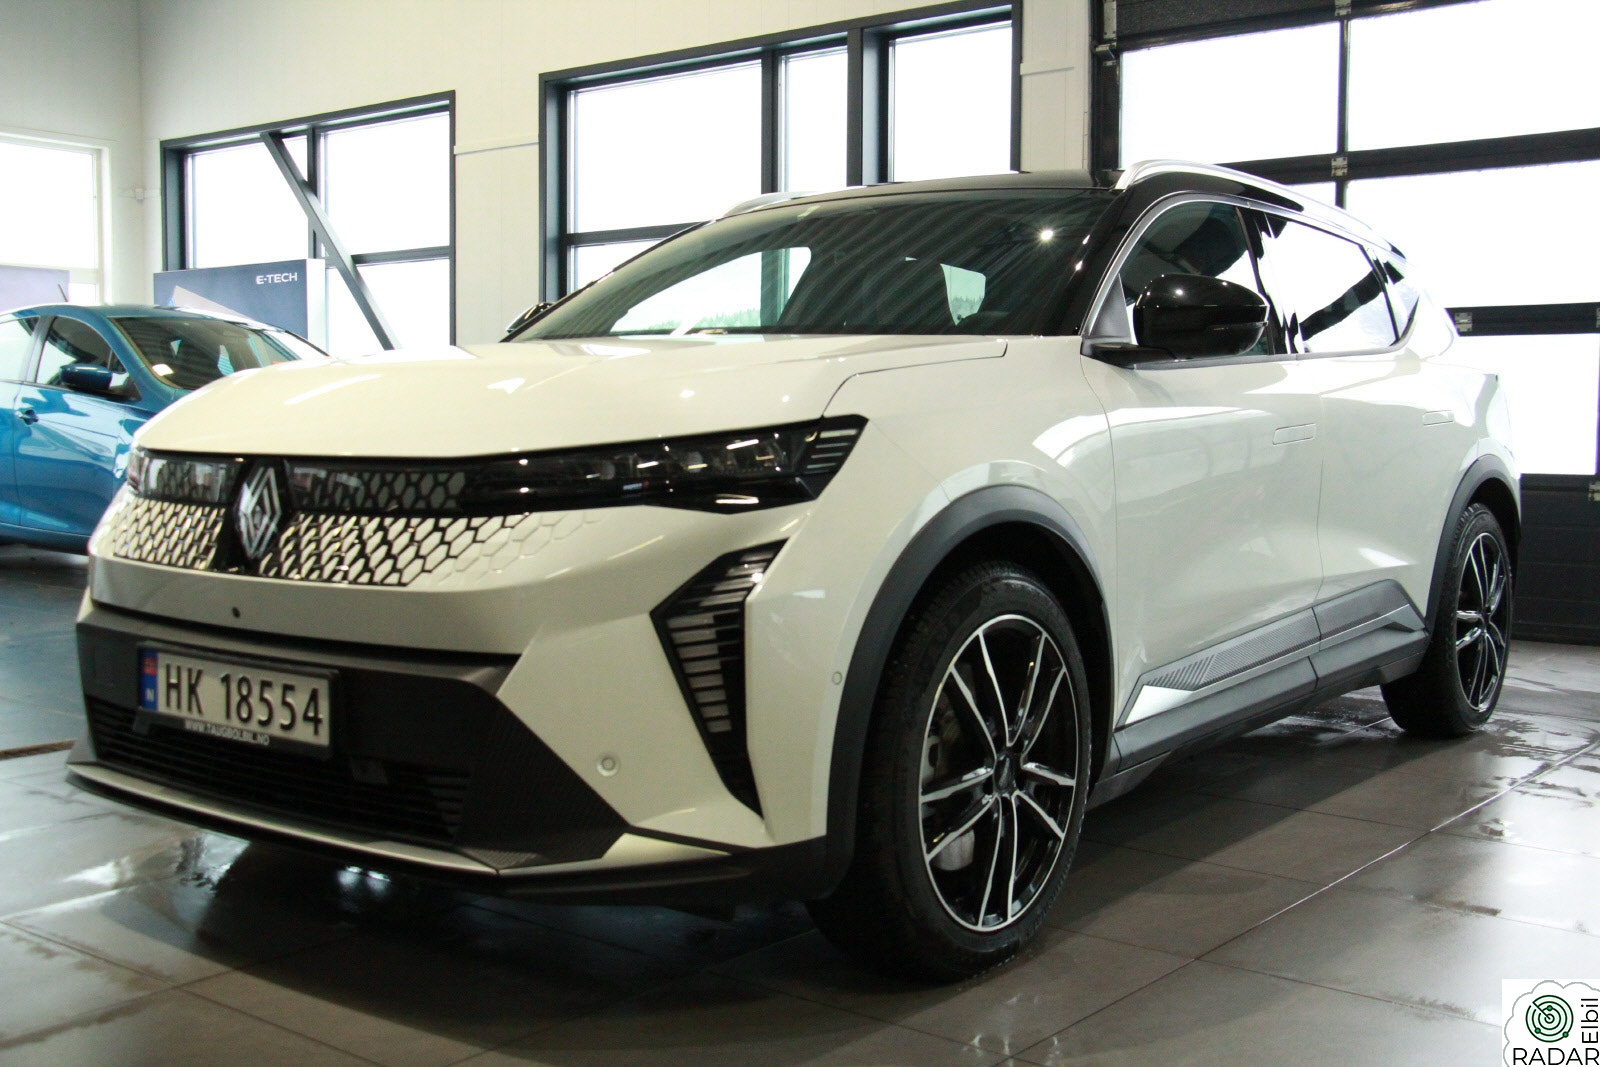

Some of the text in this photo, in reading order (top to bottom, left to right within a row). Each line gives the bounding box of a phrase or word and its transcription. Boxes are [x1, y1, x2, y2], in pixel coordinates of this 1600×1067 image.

[256, 272, 298, 284] E-TECH
[146, 688, 155, 702] N
[166, 663, 323, 735] HK 18554
